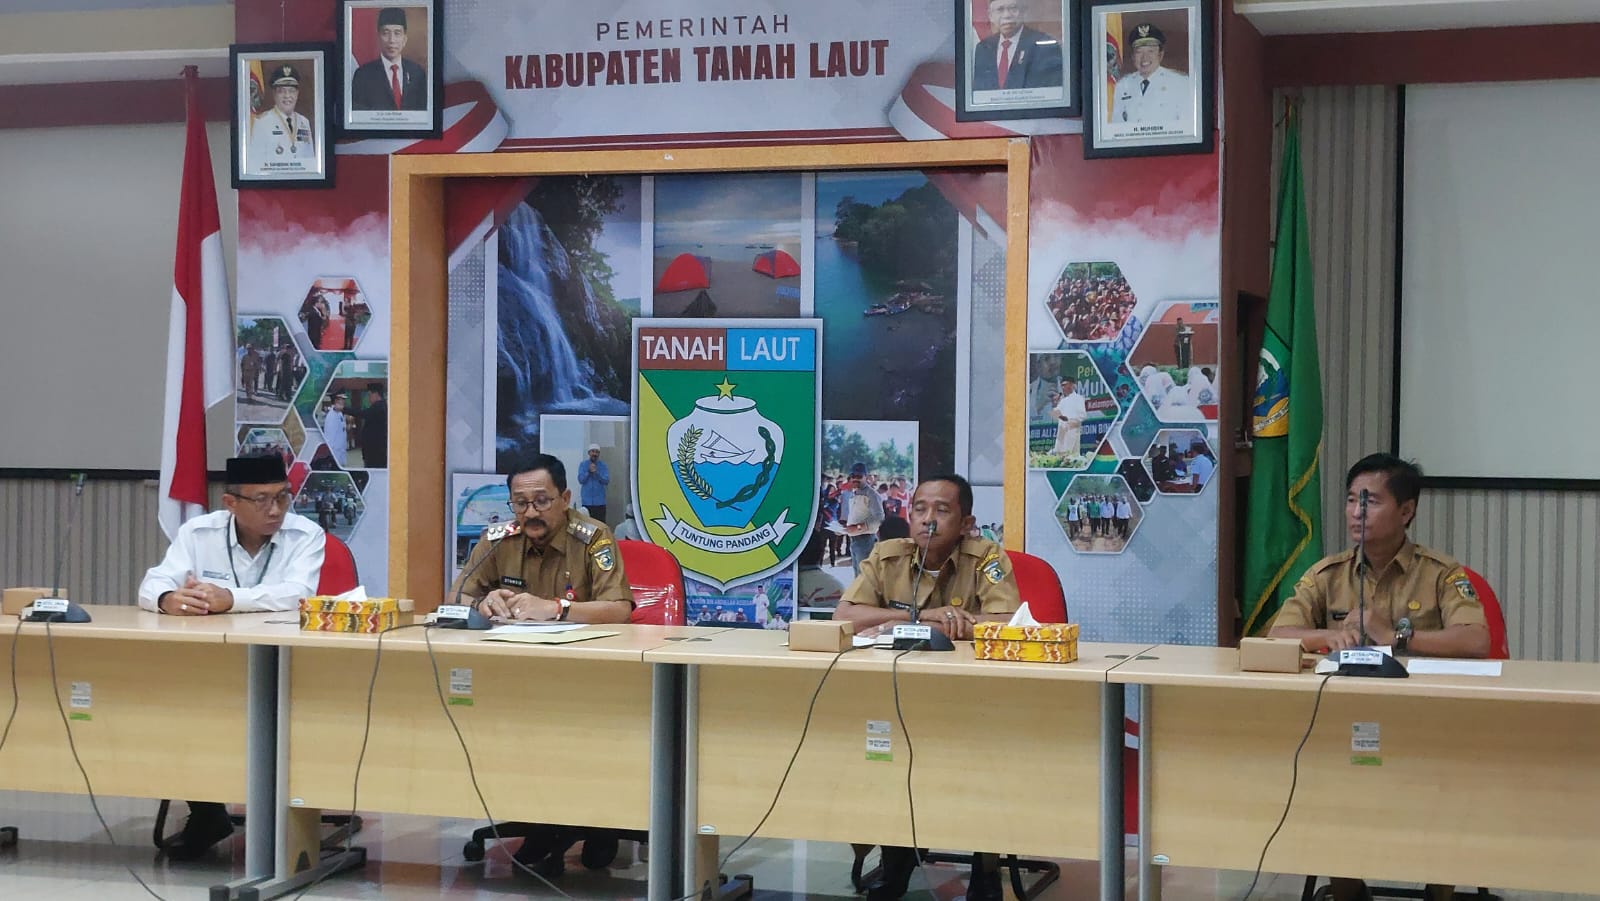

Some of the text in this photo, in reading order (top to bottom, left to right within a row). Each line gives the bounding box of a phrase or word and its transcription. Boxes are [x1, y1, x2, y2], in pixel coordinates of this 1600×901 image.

[596, 14, 789, 41] PEMERINTAH
[505, 39, 890, 90] KABUPATEN TANAH LAUT
[642, 335, 801, 361] TANAH LAUT
[680, 526, 771, 549] TUNTUNG PANDANG
